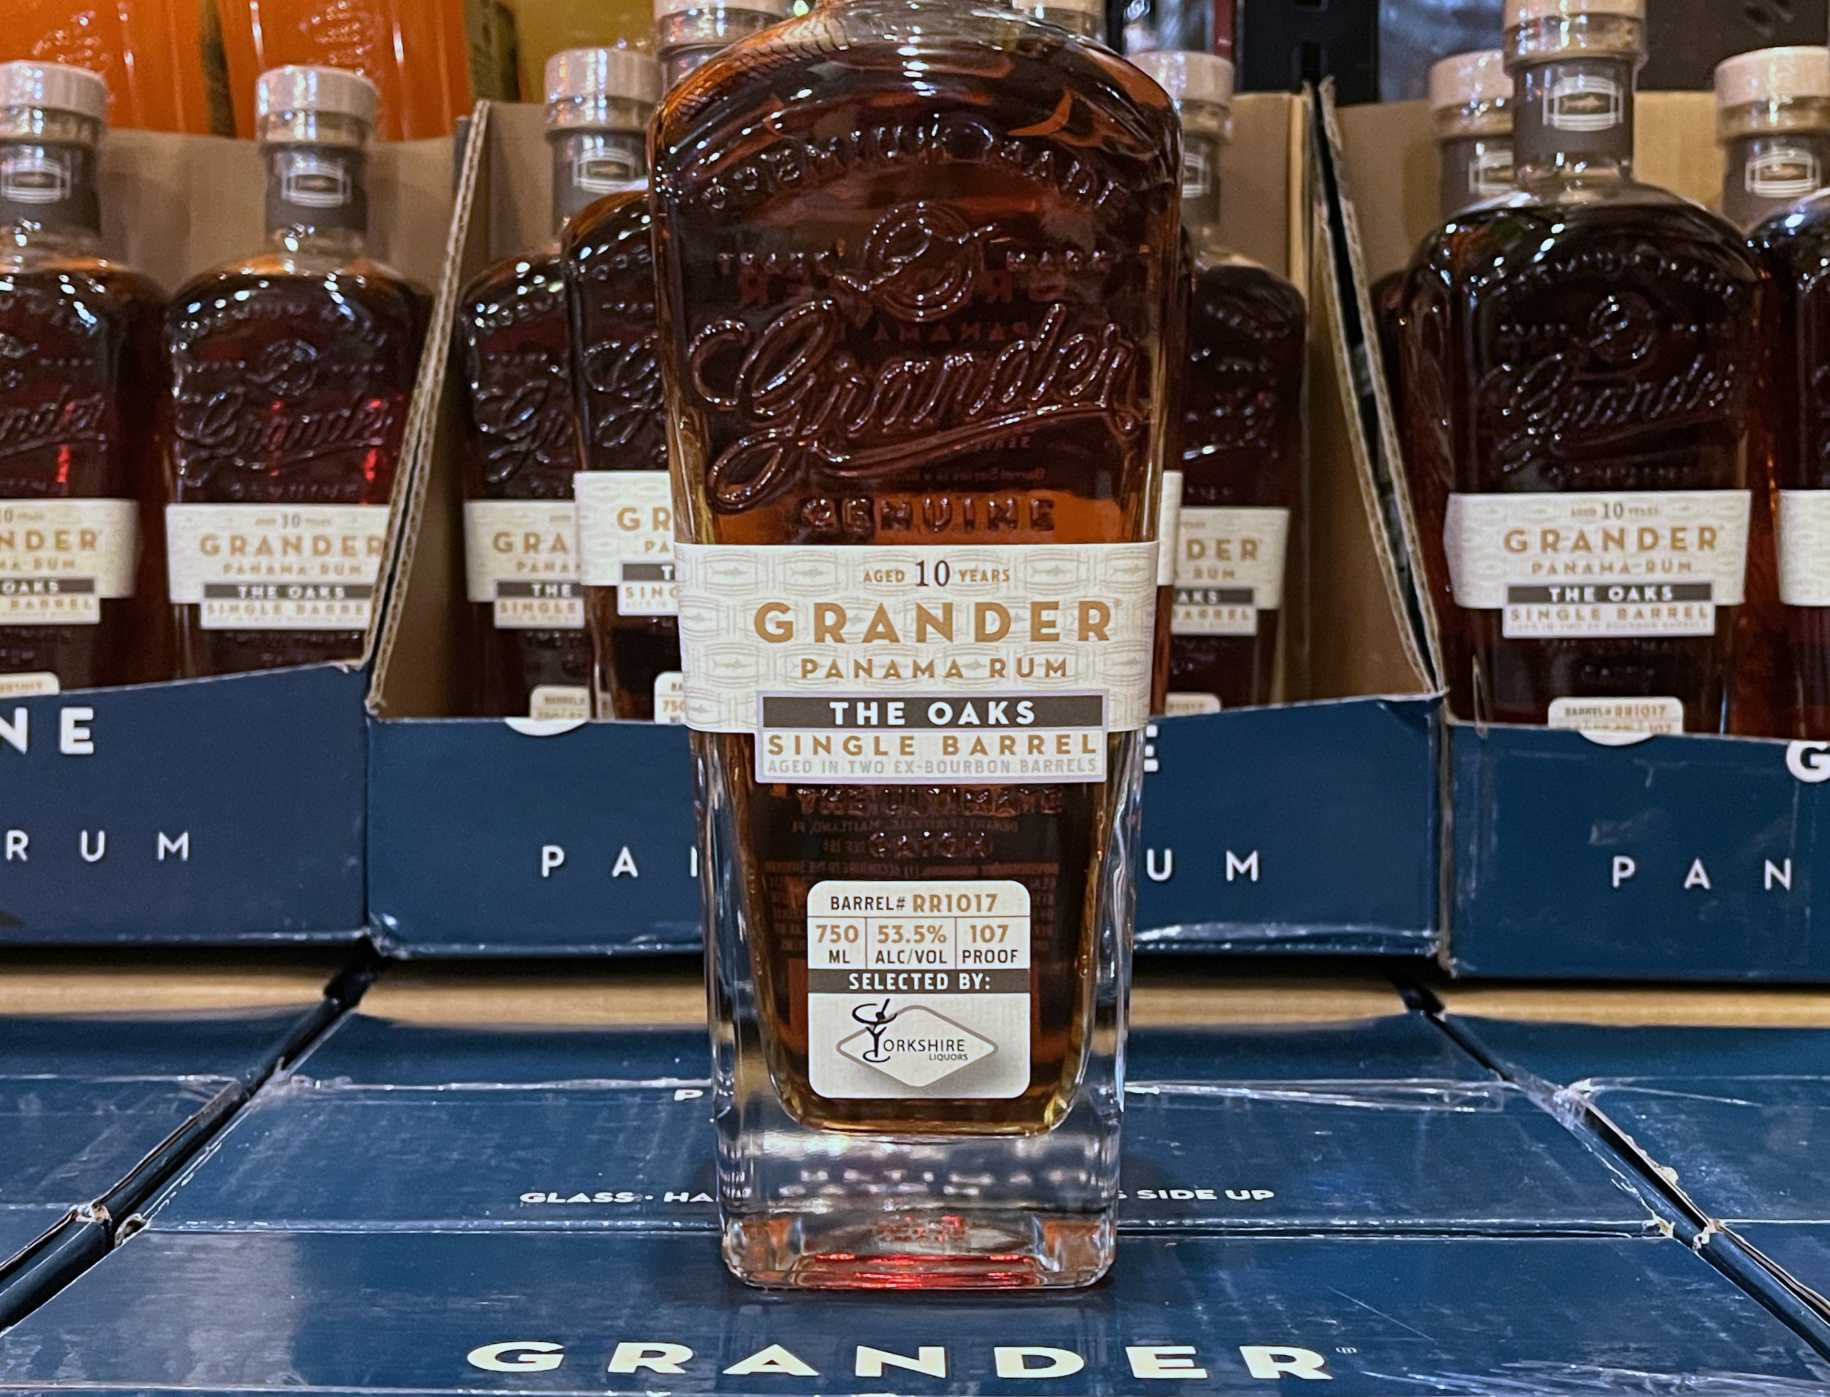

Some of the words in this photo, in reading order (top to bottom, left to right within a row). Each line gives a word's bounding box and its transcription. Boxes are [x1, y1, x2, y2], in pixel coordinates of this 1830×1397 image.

[1602, 502, 1624, 519] 10
[200, 533, 384, 557] GRANDER
[1504, 526, 1718, 553] GRANDER
[864, 568, 905, 584] AGED
[914, 559, 951, 588] 10
[959, 567, 1010, 583] YEARS
[1532, 560, 1631, 575] PANAMA
[1646, 559, 1693, 574] RUM
[530, 583, 573, 597] THE
[1549, 586, 1596, 602] THE
[1608, 585, 1674, 601] OAKS
[753, 600, 1114, 644] GRANDER
[1511, 608, 1601, 622] SINGLE
[1617, 606, 1708, 621] BARREL
[800, 657, 961, 680] PANAMA
[989, 657, 1068, 679] RUM
[829, 701, 906, 726] THE
[927, 700, 1036, 726] OAKS
[767, 735, 916, 757] SINGLE
[942, 733, 1097, 757] BARREL
[767, 758, 812, 774] AGED
[821, 758, 839, 774] IN
[849, 758, 886, 774] TWO
[894, 757, 1011, 774] EX-BOURBON
[1020, 756, 1097, 773] BARRELS
[6, 829, 189, 863] RUM
[831, 895, 906, 912] BARREL#
[911, 893, 998, 913] RR1017
[815, 924, 860, 944] 750
[876, 924, 948, 944] 53.5%
[969, 924, 1010, 944] 107
[828, 950, 852, 965] ML
[875, 948, 948, 965] ALC/VOL
[961, 949, 1019, 964] PROOF
[848, 972, 949, 990] SELECTED
[958, 972, 992, 990] BY:
[928, 1053, 969, 1062] LIQUORS
[519, 1191, 636, 1203] GLASS
[1136, 1188, 1218, 1200] SIDE
[1224, 1188, 1276, 1201] UP
[467, 1341, 1335, 1381] GRANDER
